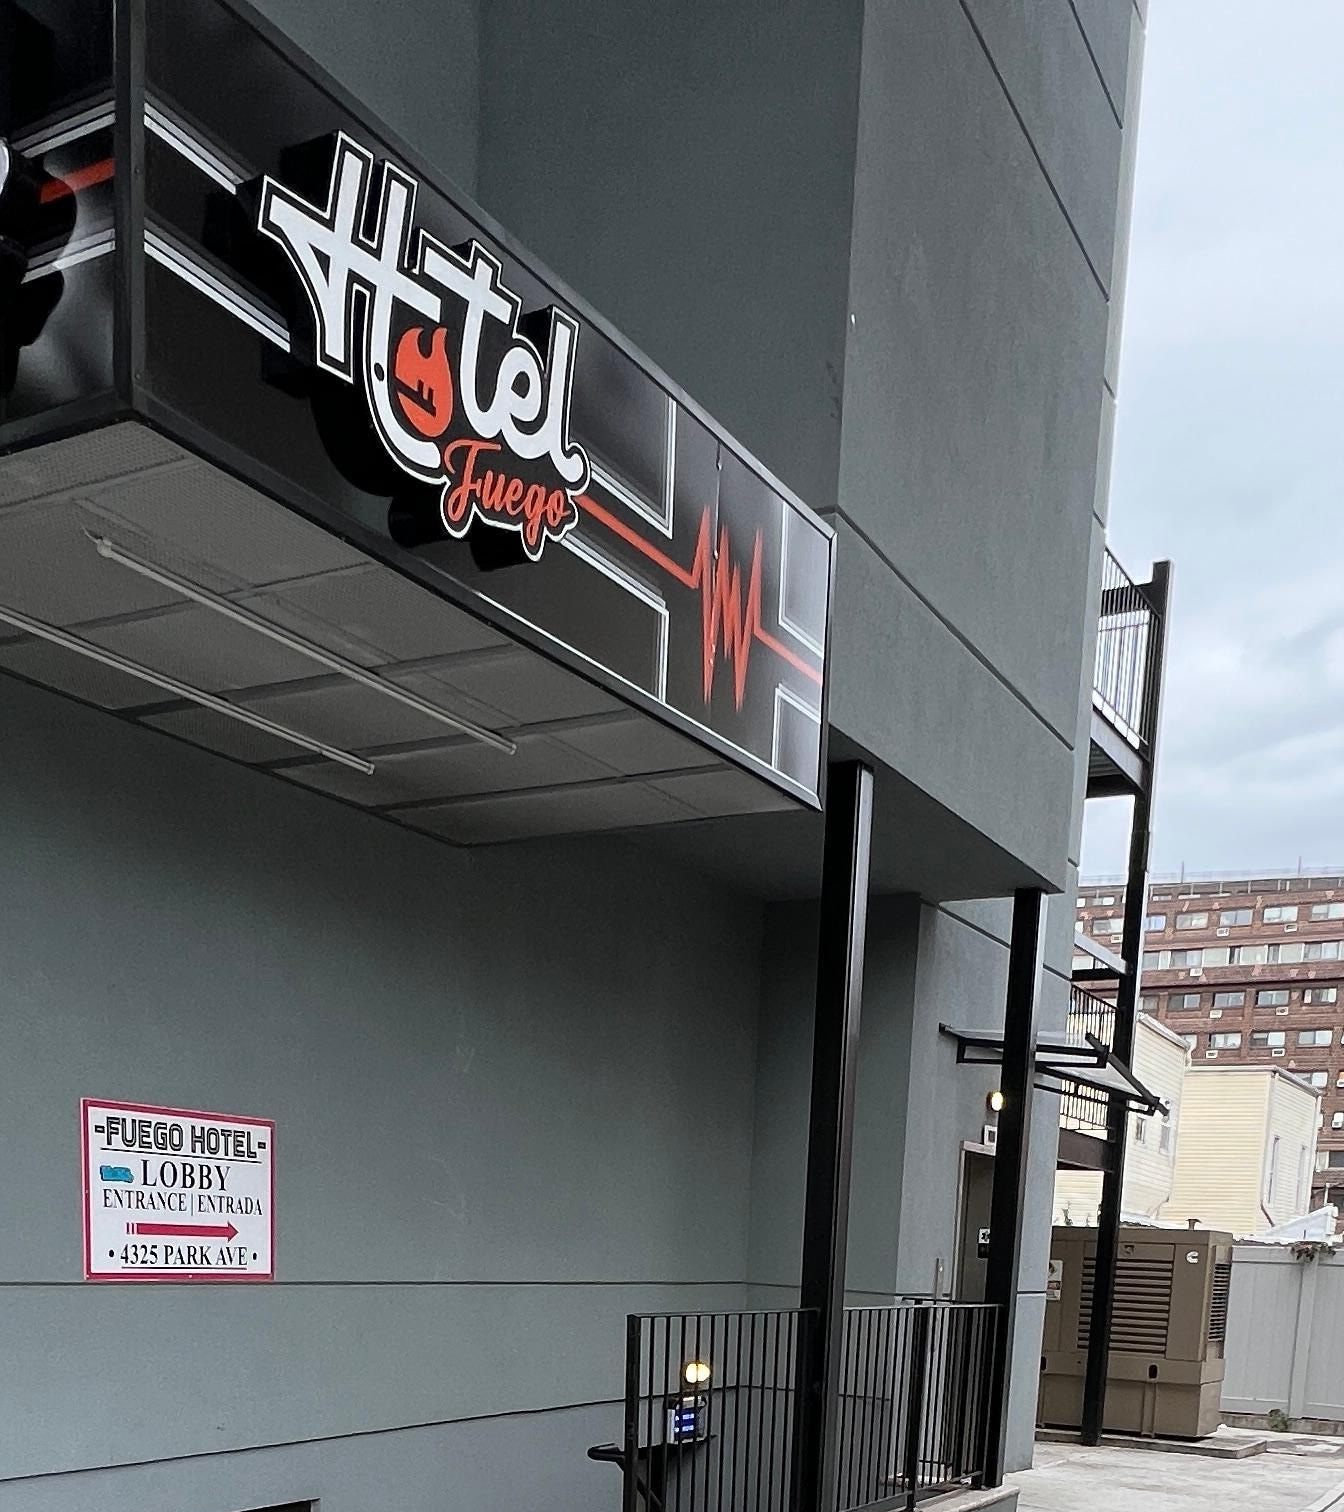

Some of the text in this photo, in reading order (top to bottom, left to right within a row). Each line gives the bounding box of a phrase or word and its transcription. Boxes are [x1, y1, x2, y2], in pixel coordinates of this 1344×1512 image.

[444, 438, 573, 547] Fuego
[140, 1159, 231, 1192] LOBBY
[103, 1188, 263, 1216] ENTRANCE ENTRADA
[120, 1244, 249, 1266] 4325 PARK AVE
